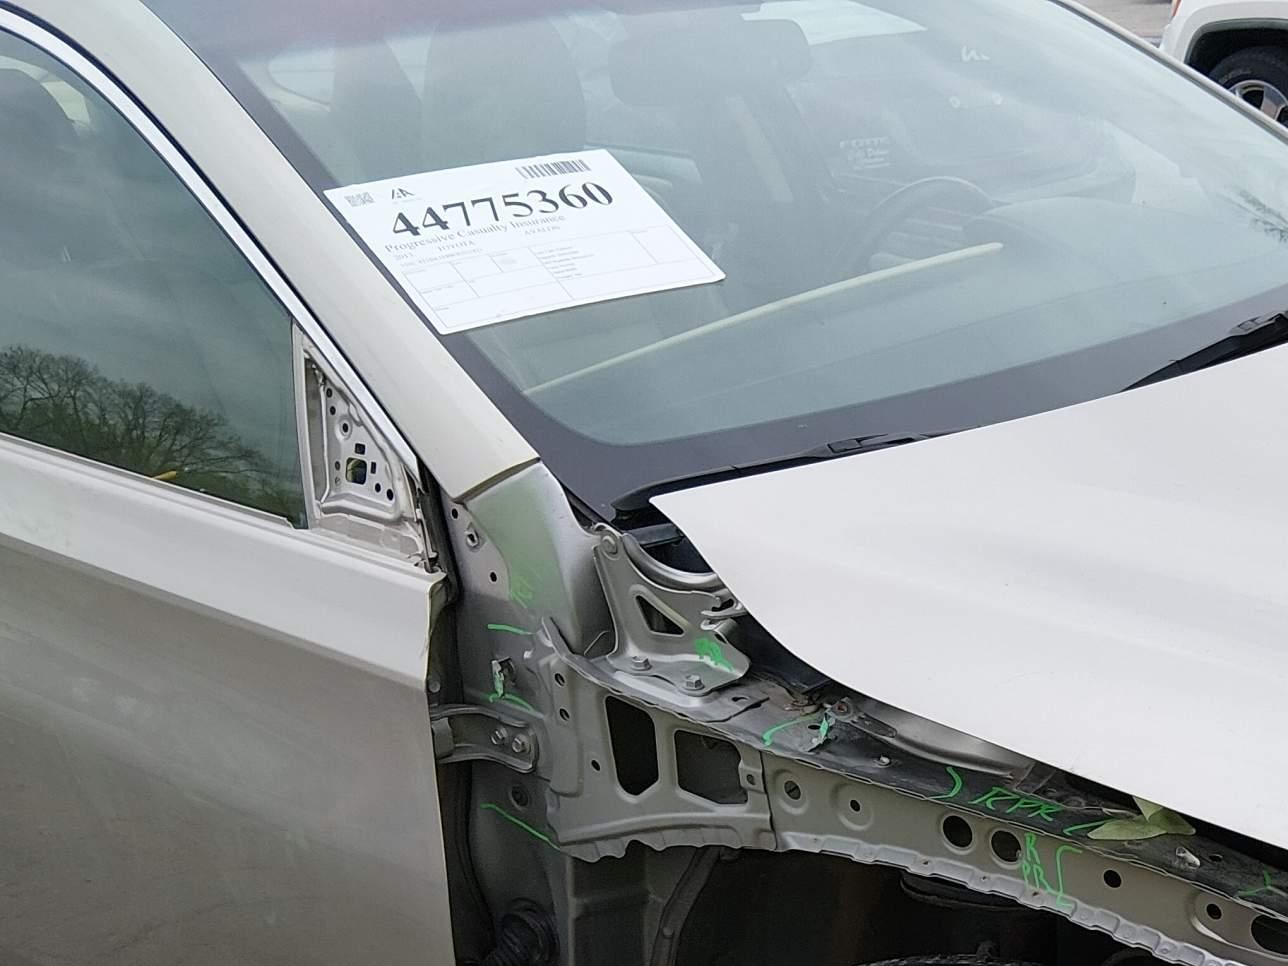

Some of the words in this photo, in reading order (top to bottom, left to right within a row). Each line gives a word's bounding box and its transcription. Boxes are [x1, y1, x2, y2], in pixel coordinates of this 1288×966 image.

[392, 181, 614, 236] 44775360
[385, 233, 455, 253] Progressive
[457, 223, 508, 237] Casualty
[511, 215, 566, 229] Insurance
